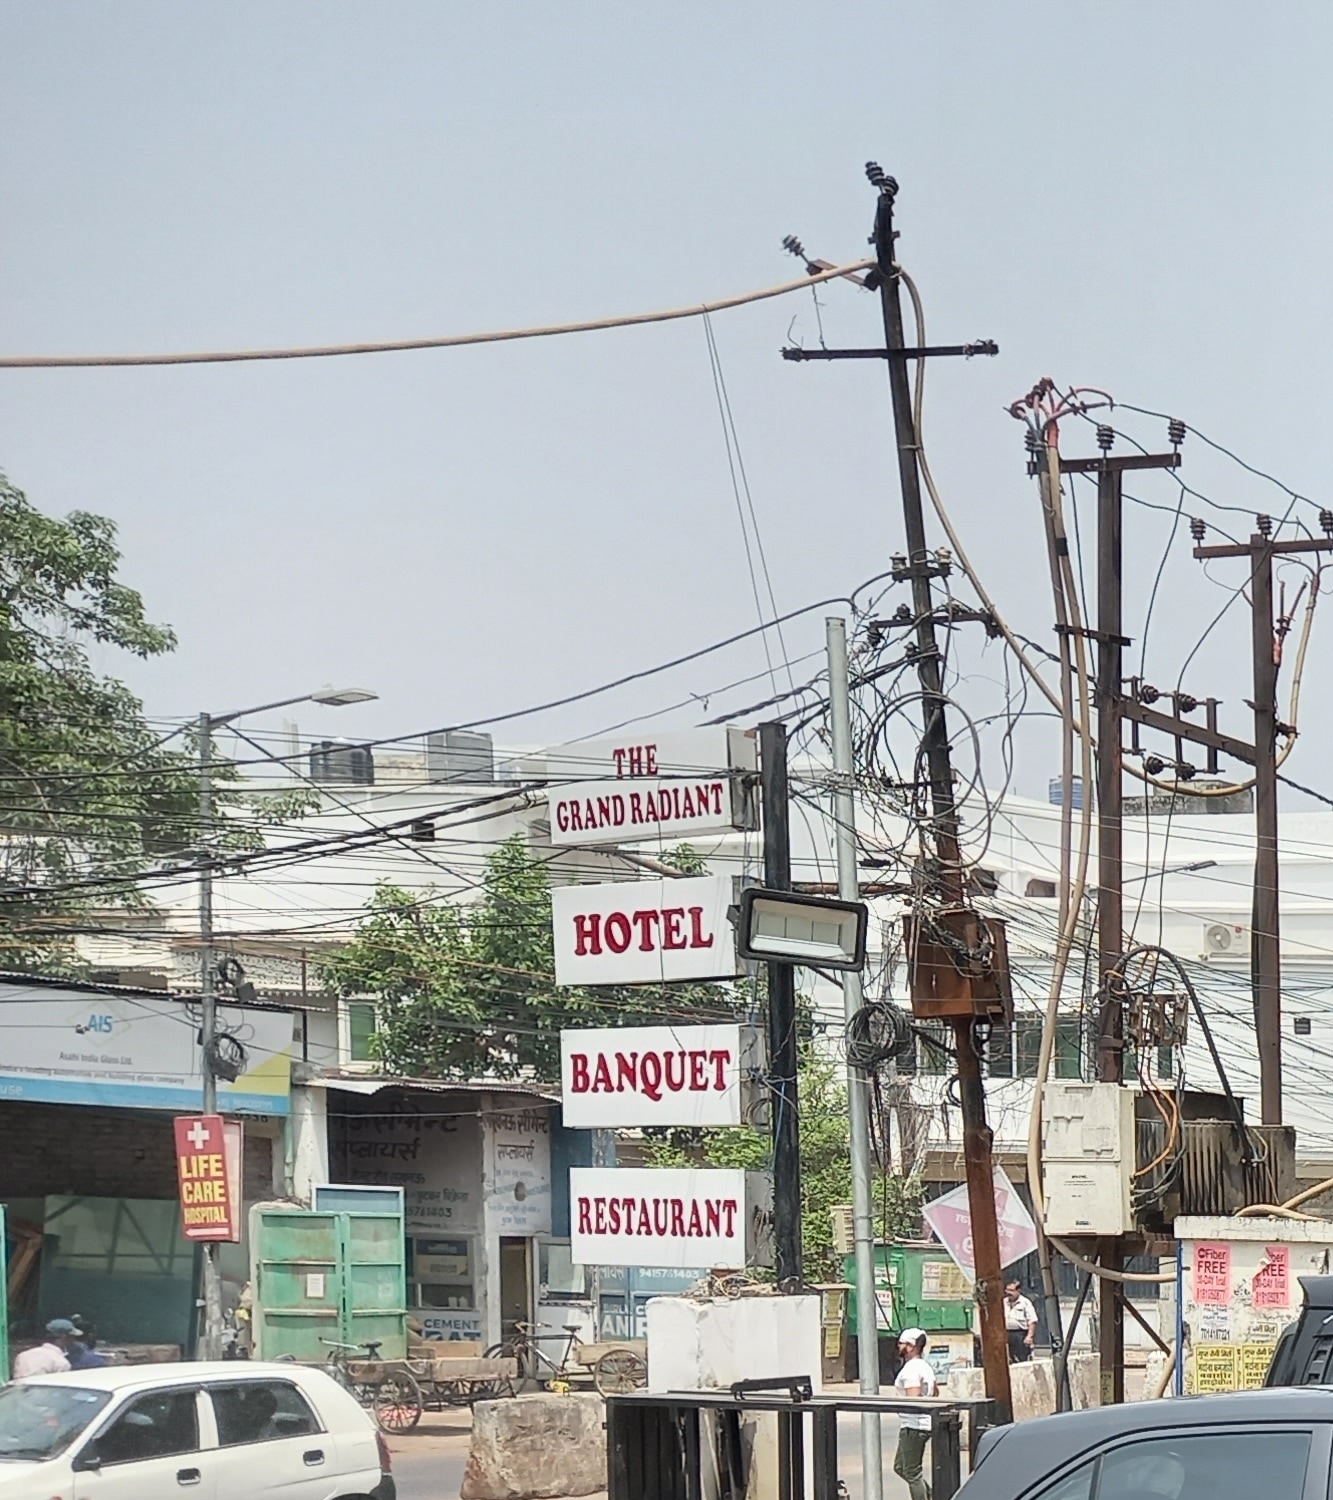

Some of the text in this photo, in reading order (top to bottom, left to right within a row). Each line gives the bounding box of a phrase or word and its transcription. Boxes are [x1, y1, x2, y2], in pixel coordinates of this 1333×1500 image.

[612, 744, 659, 779] THE
[556, 782, 724, 833] GRAND RADIANT
[573, 906, 714, 956] HOTEL
[88, 1014, 113, 1033] AIS
[570, 1048, 731, 1102] BANQUET
[180, 1154, 224, 1179] LIFE
[182, 1180, 226, 1204] CARE
[184, 1206, 229, 1225] HOSPITAL
[577, 1198, 738, 1239] RESTAURANT
[1197, 1260, 1227, 1275] FREE
[1262, 1263, 1286, 1277] REE
[424, 1318, 480, 1330] CEMENT
